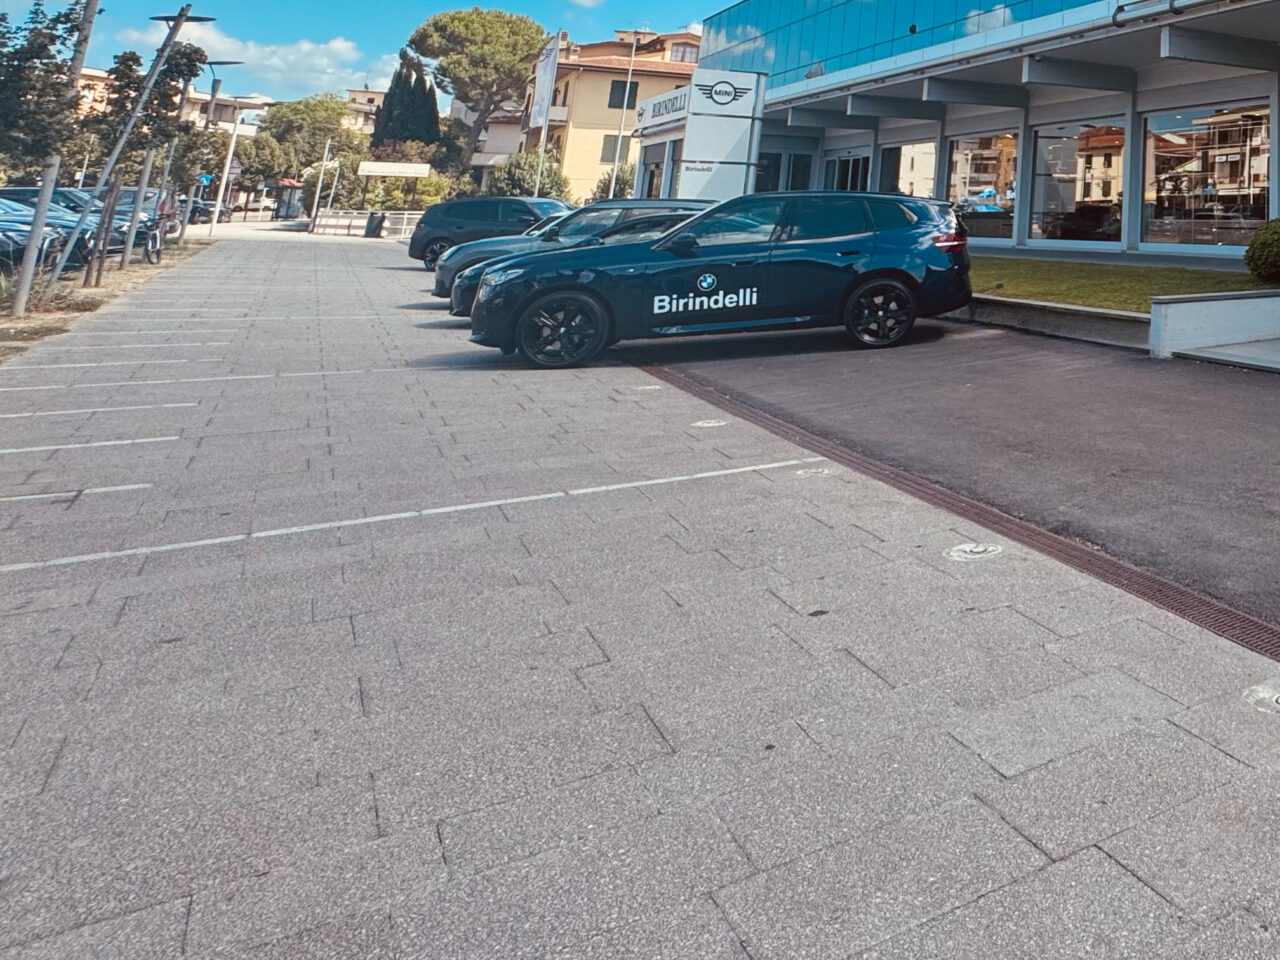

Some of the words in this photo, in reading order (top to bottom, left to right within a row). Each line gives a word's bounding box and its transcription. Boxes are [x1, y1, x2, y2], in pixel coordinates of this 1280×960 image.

[651, 93, 687, 118] BIRINDELLI
[713, 89, 734, 97] MINI
[653, 287, 758, 314] Birindelli
